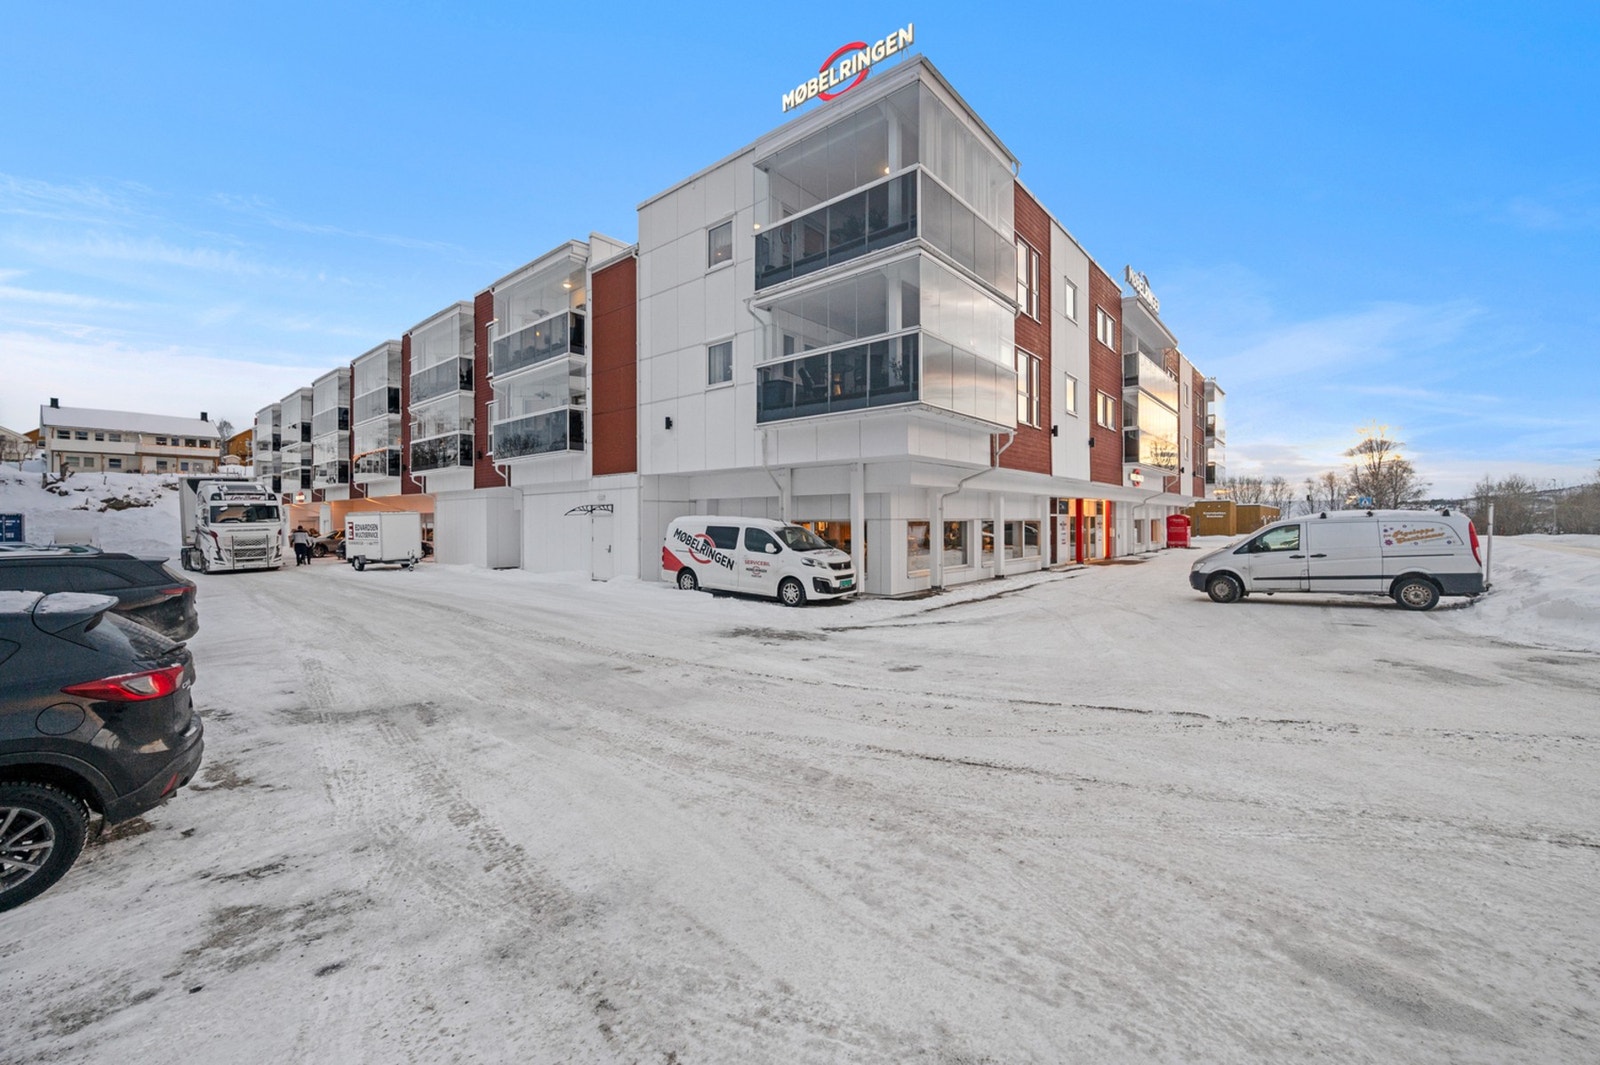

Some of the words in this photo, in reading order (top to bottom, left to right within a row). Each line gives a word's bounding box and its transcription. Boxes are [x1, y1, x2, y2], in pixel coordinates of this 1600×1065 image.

[782, 23, 915, 113] MØBELRINGEN
[673, 527, 736, 571] MØBELRINGEN
[744, 559, 771, 567] SERVICEBIL
